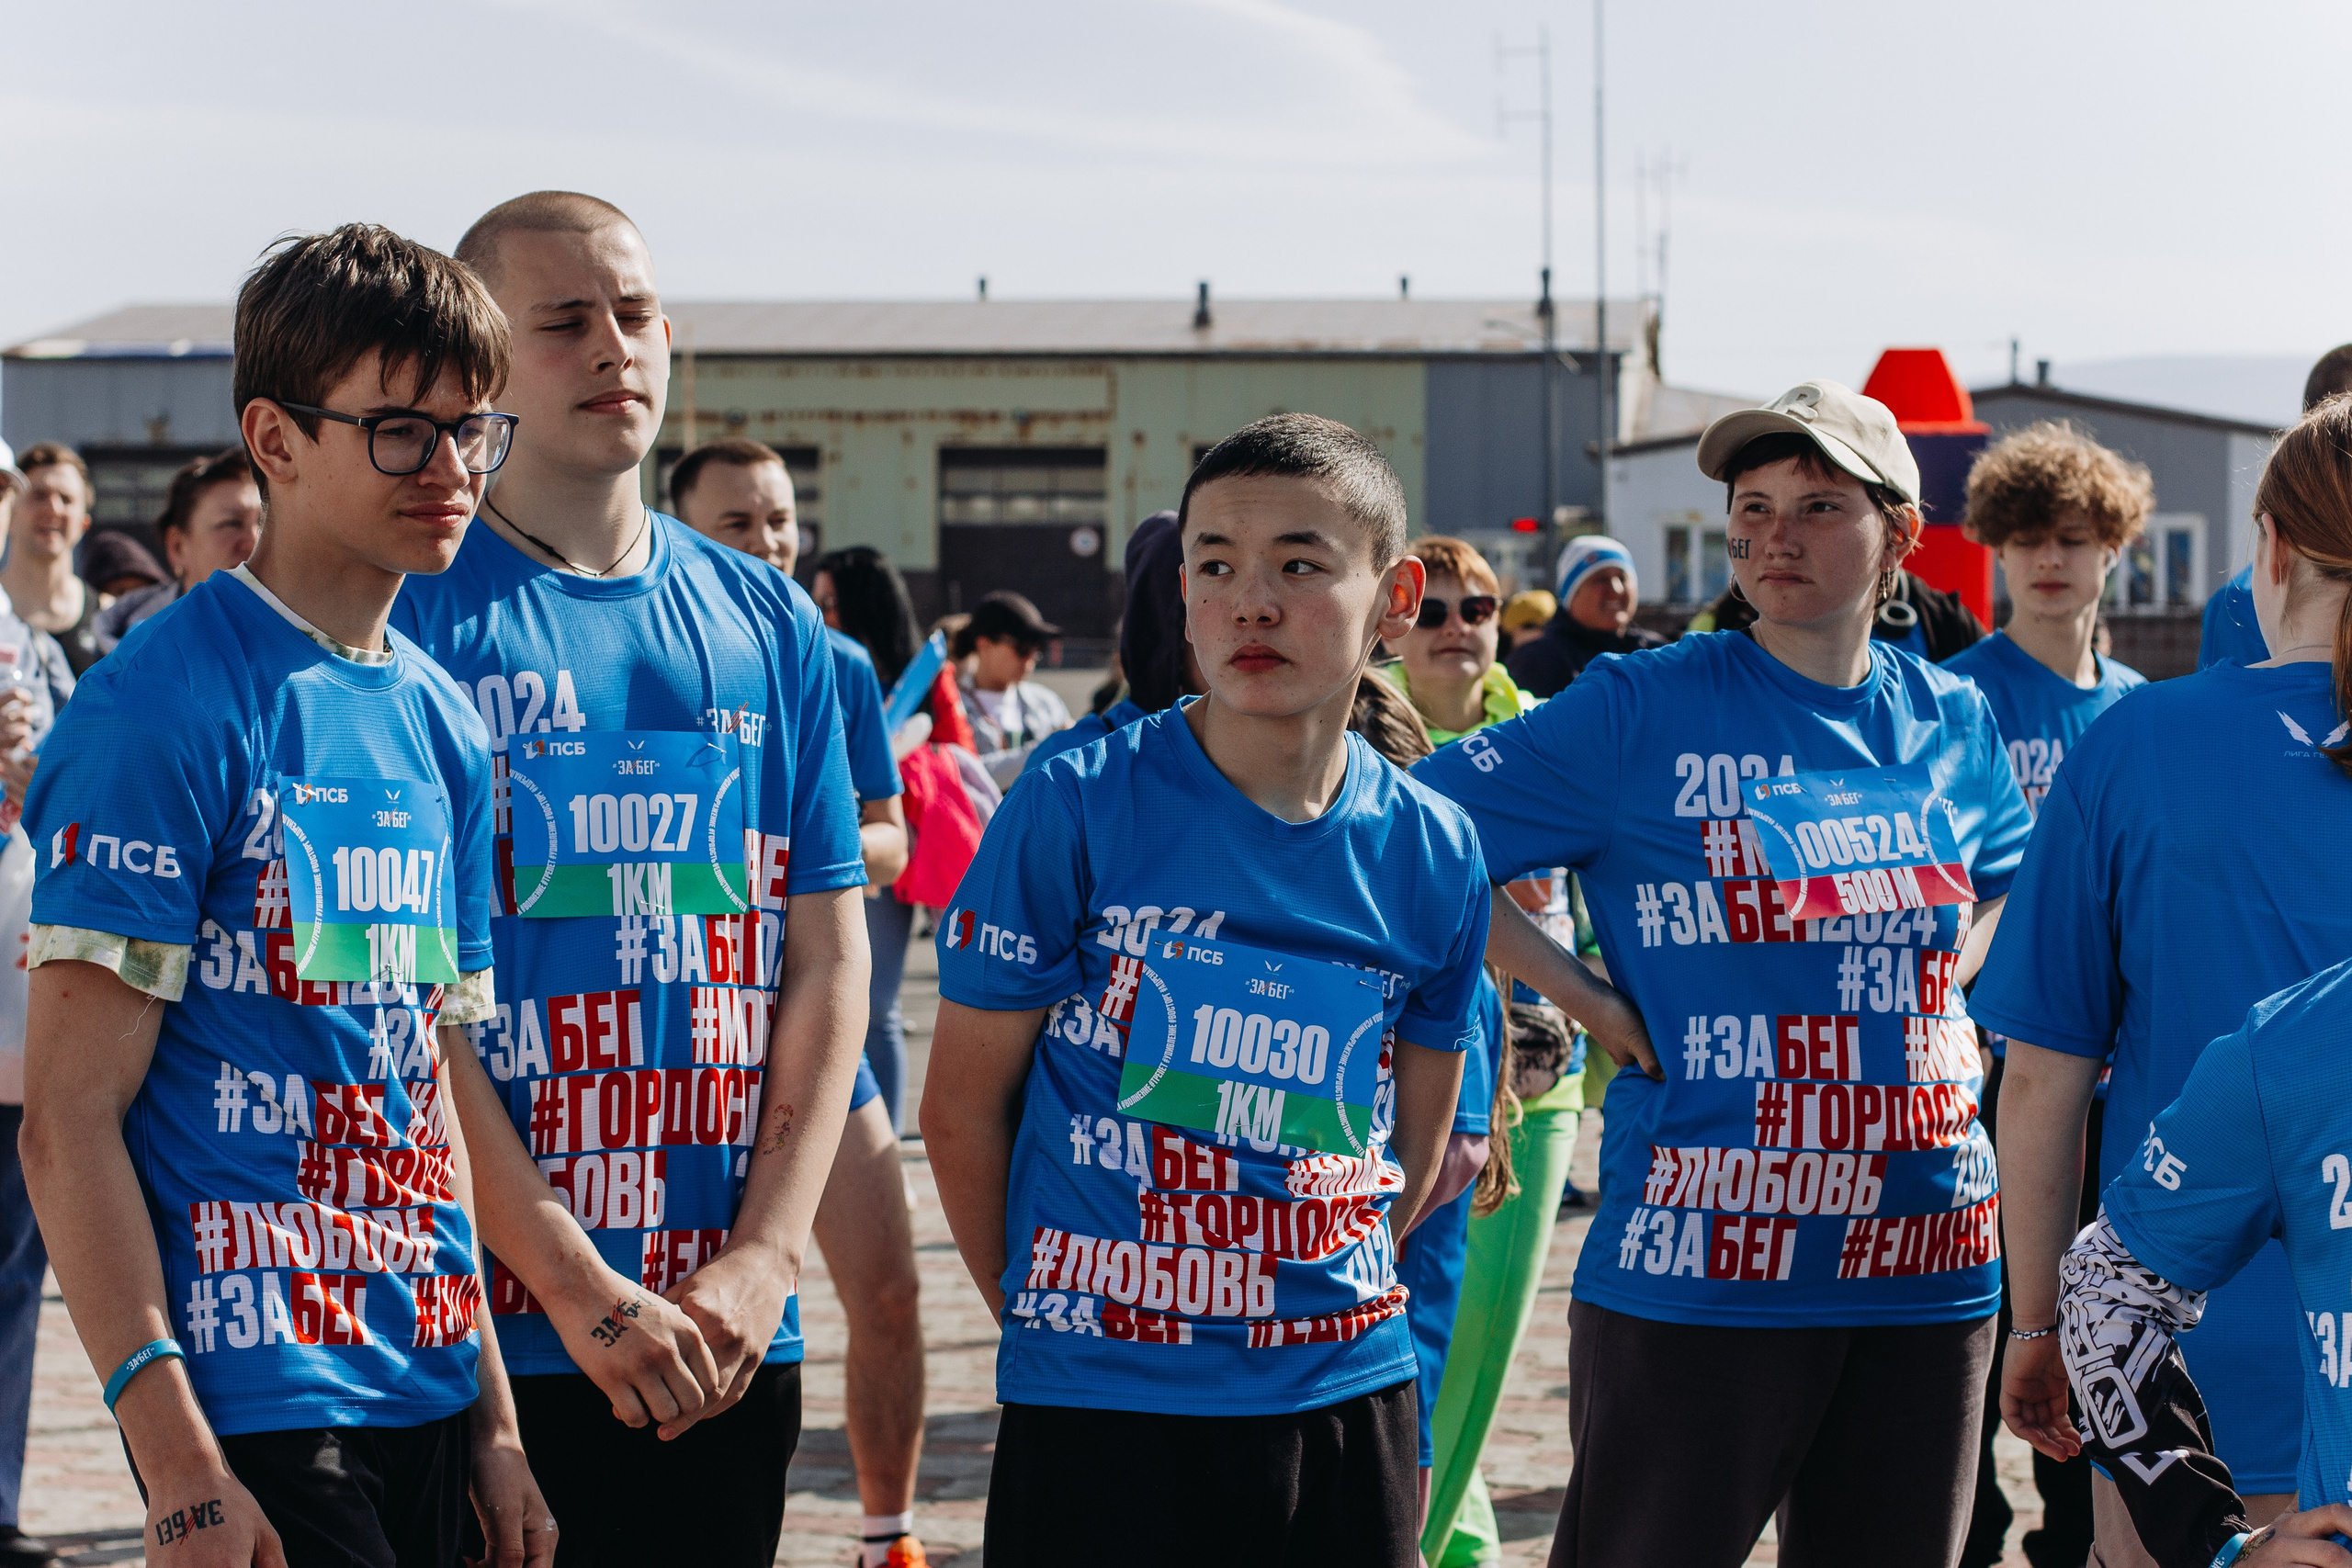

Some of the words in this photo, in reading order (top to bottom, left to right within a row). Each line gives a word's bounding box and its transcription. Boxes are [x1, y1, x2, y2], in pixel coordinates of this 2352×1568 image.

[458, 670, 586, 752] 024
[548, 741, 586, 756] ПСБ
[2007, 738, 2064, 787] 024
[315, 787, 349, 804] ПСБ
[1772, 783, 1802, 796] ПСБ
[569, 794, 698, 853] 10027
[1794, 811, 1928, 869] 00524
[86, 834, 182, 879] ПСБ
[333, 846, 435, 914] 10047
[978, 923, 1037, 965] ПСБ
[1187, 946, 1224, 965] ПСБ
[1193, 1003, 1329, 1085] 10030
[1683, 1014, 1861, 1081] #ЗАБЕГ
[1070, 1113, 1238, 1192] #ЗАБЕГ
[1643, 1145, 1888, 1215] #ЛЮБОВЬ
[1026, 1226, 1278, 1317] #ЛЮБОВЬ
[1619, 1207, 1798, 1280] #ЗАБЕГ
[187, 1273, 375, 1355] #ЗАБЕГ
